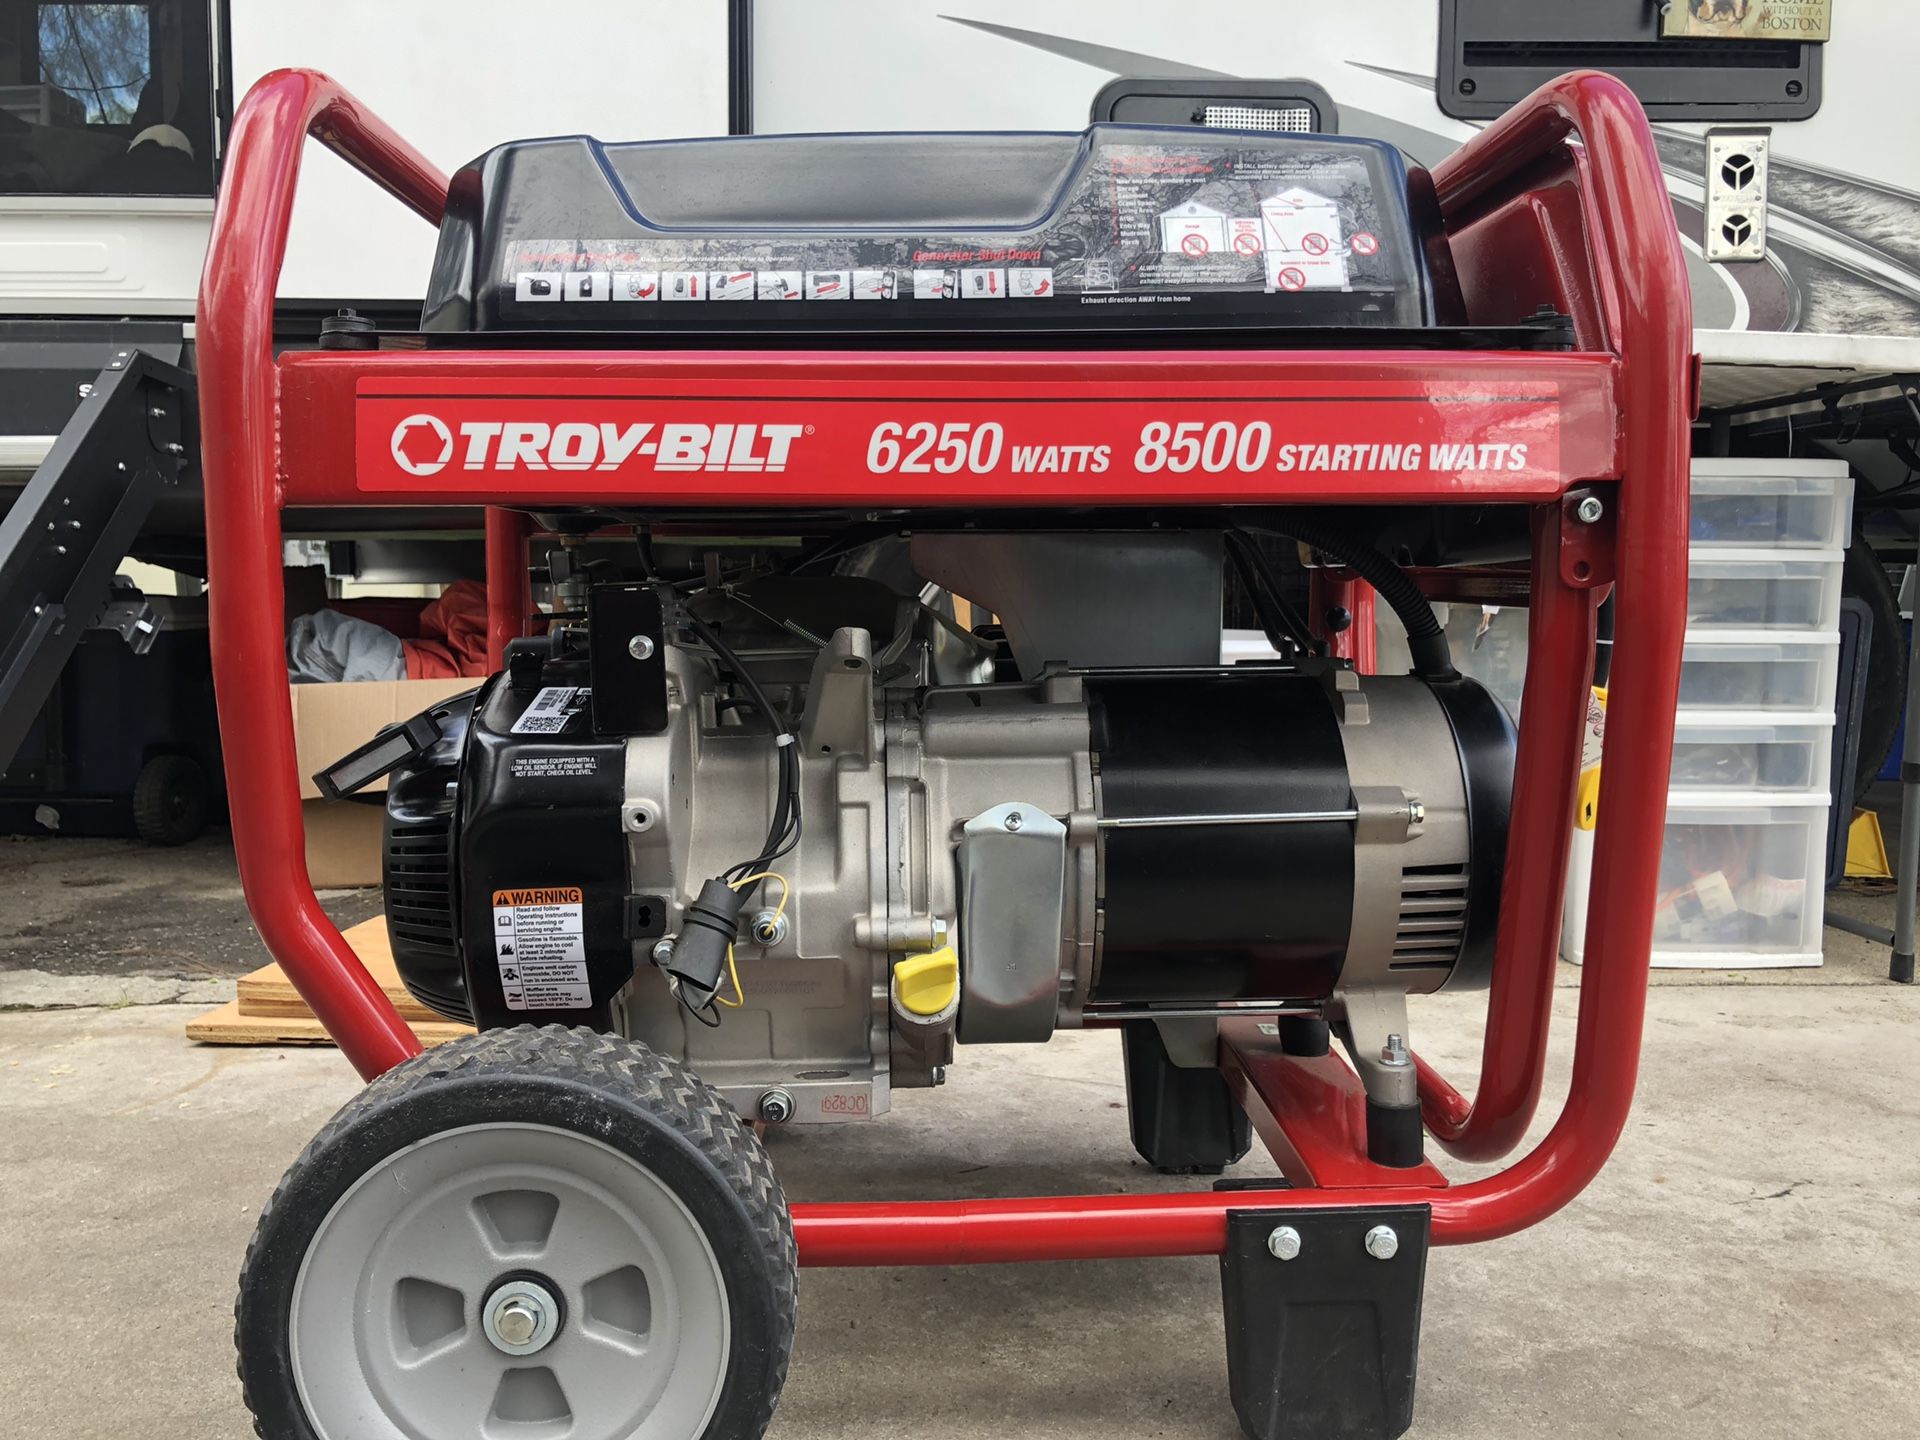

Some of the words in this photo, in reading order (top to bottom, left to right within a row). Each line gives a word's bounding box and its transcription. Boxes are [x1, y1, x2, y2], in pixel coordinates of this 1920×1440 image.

[1763, 5, 1812, 15] WITHOUT
[1815, 7, 1822, 16] A
[1762, 17, 1822, 31] BOSTON
[912, 249, 973, 261] Generator
[978, 248, 1004, 260] Shut
[1008, 248, 1040, 260] Down
[460, 422, 803, 473] TROY-BILT
[867, 421, 1004, 474] 6250
[1011, 445, 1110, 473] WATTS
[1134, 421, 1272, 473] 8500
[1276, 443, 1422, 472] STARTING
[1428, 443, 1528, 471] WATTS
[511, 889, 579, 904] WARNING
